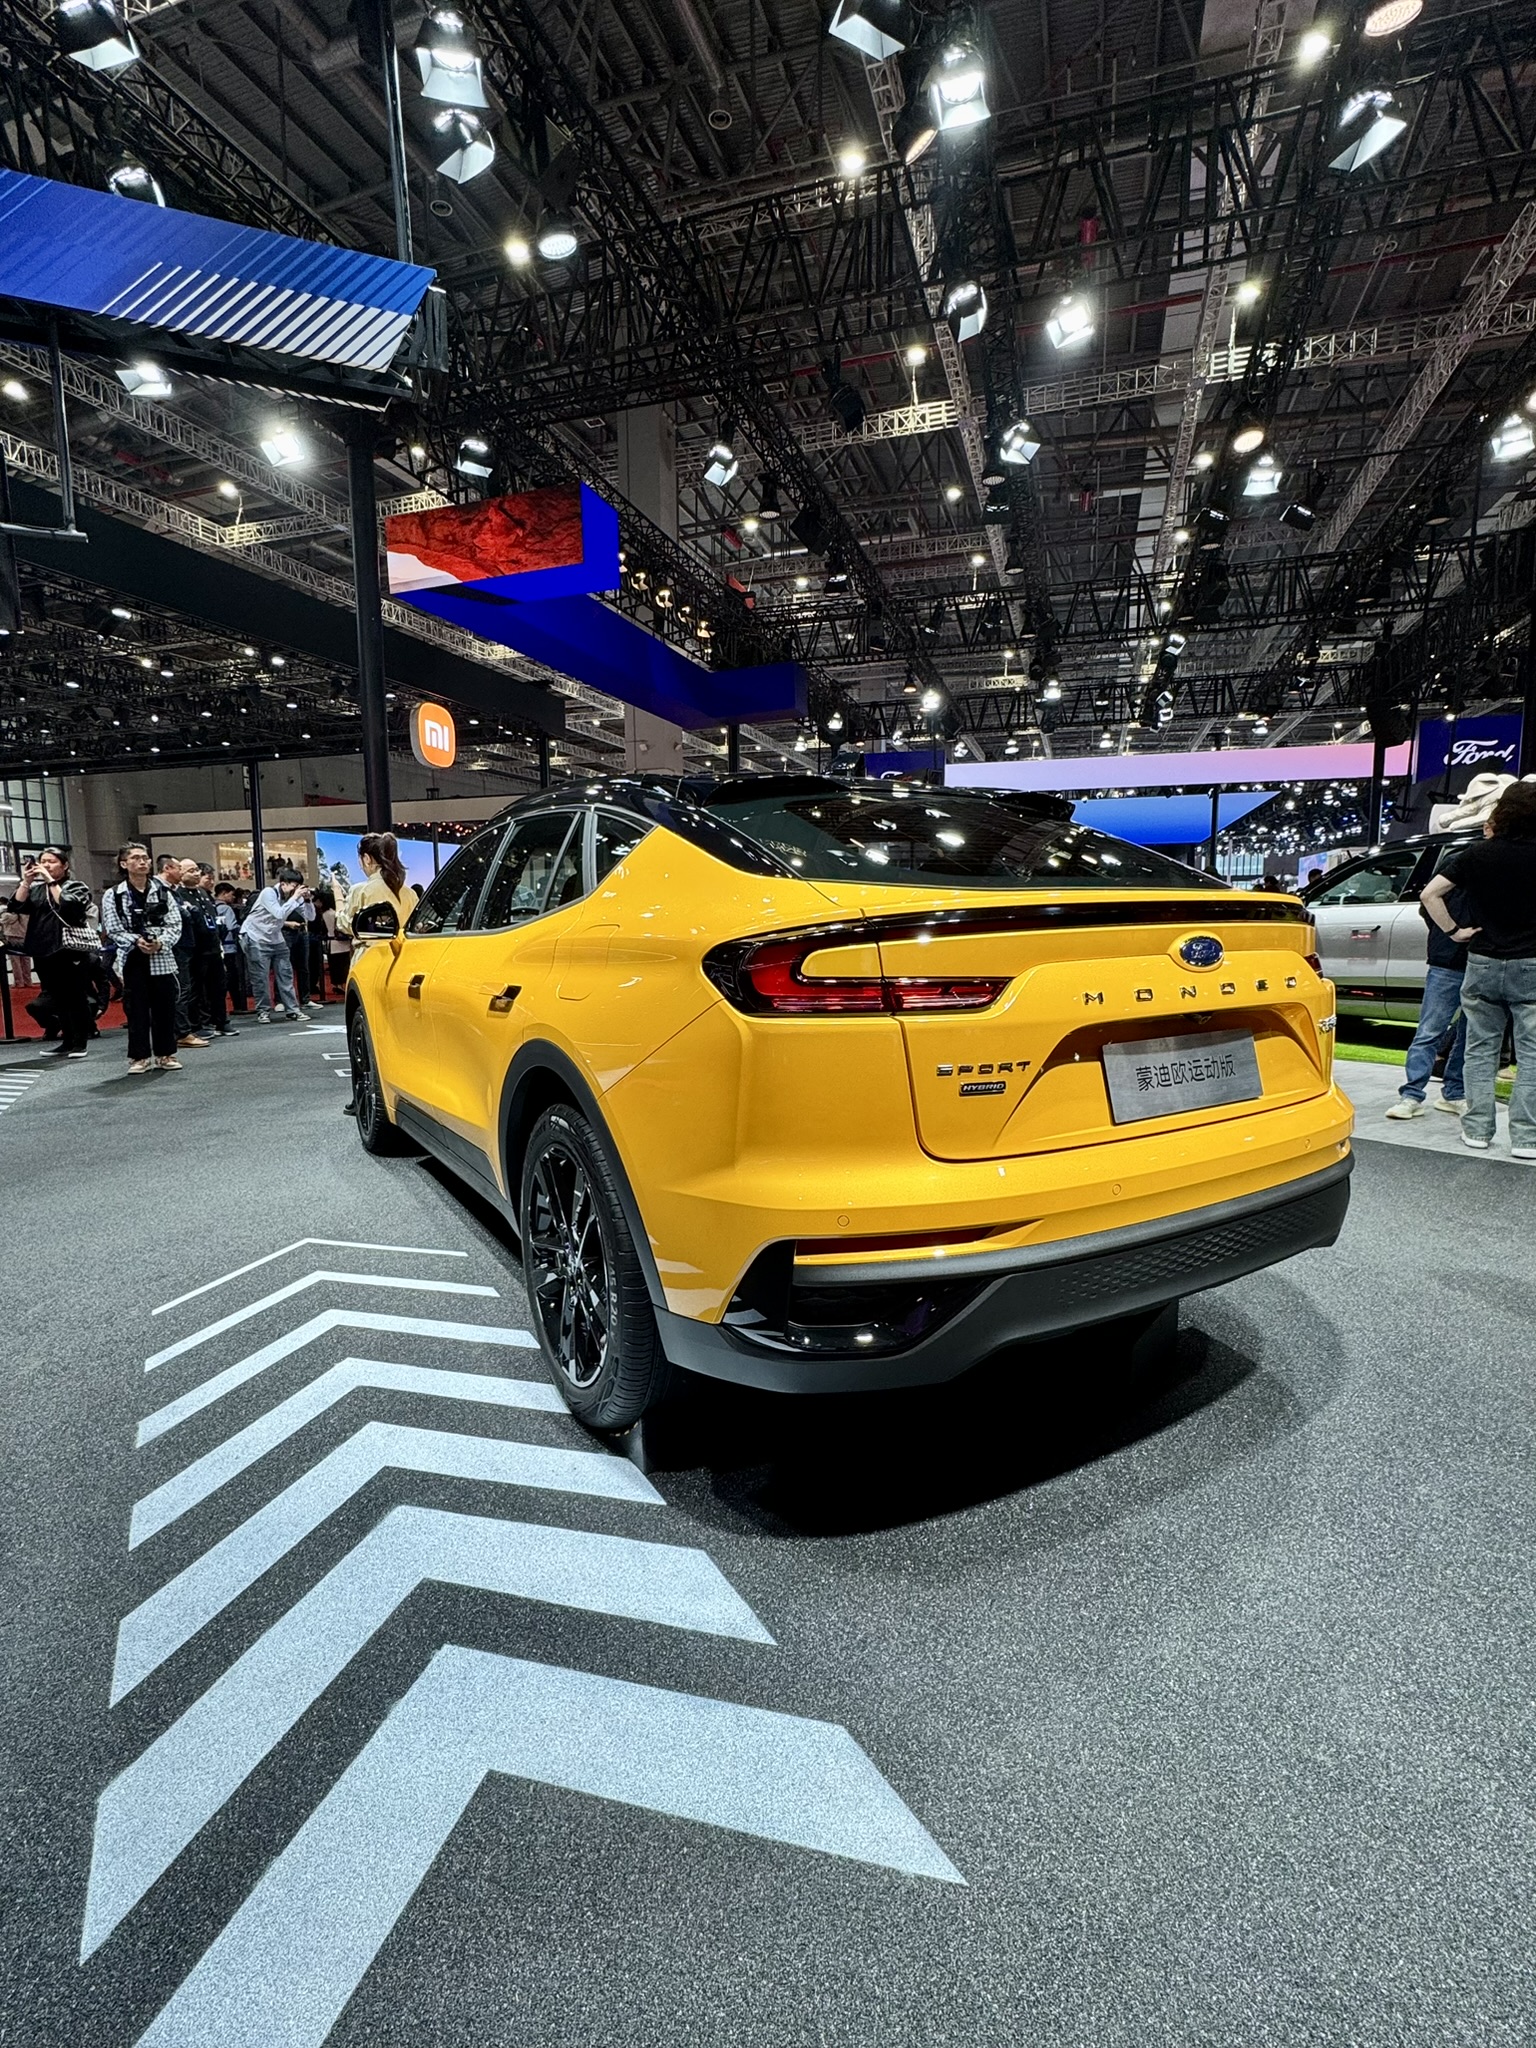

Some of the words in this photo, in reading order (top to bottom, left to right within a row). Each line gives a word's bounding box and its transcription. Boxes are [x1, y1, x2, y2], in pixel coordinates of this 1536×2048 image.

[1443, 739, 1516, 766] Ford
[1082, 976, 1297, 1006] MONDEO
[936, 1060, 1031, 1076] SPORT
[1135, 1054, 1236, 1092] 蒙迪欧运动版
[962, 1082, 1005, 1092] HYBRID
